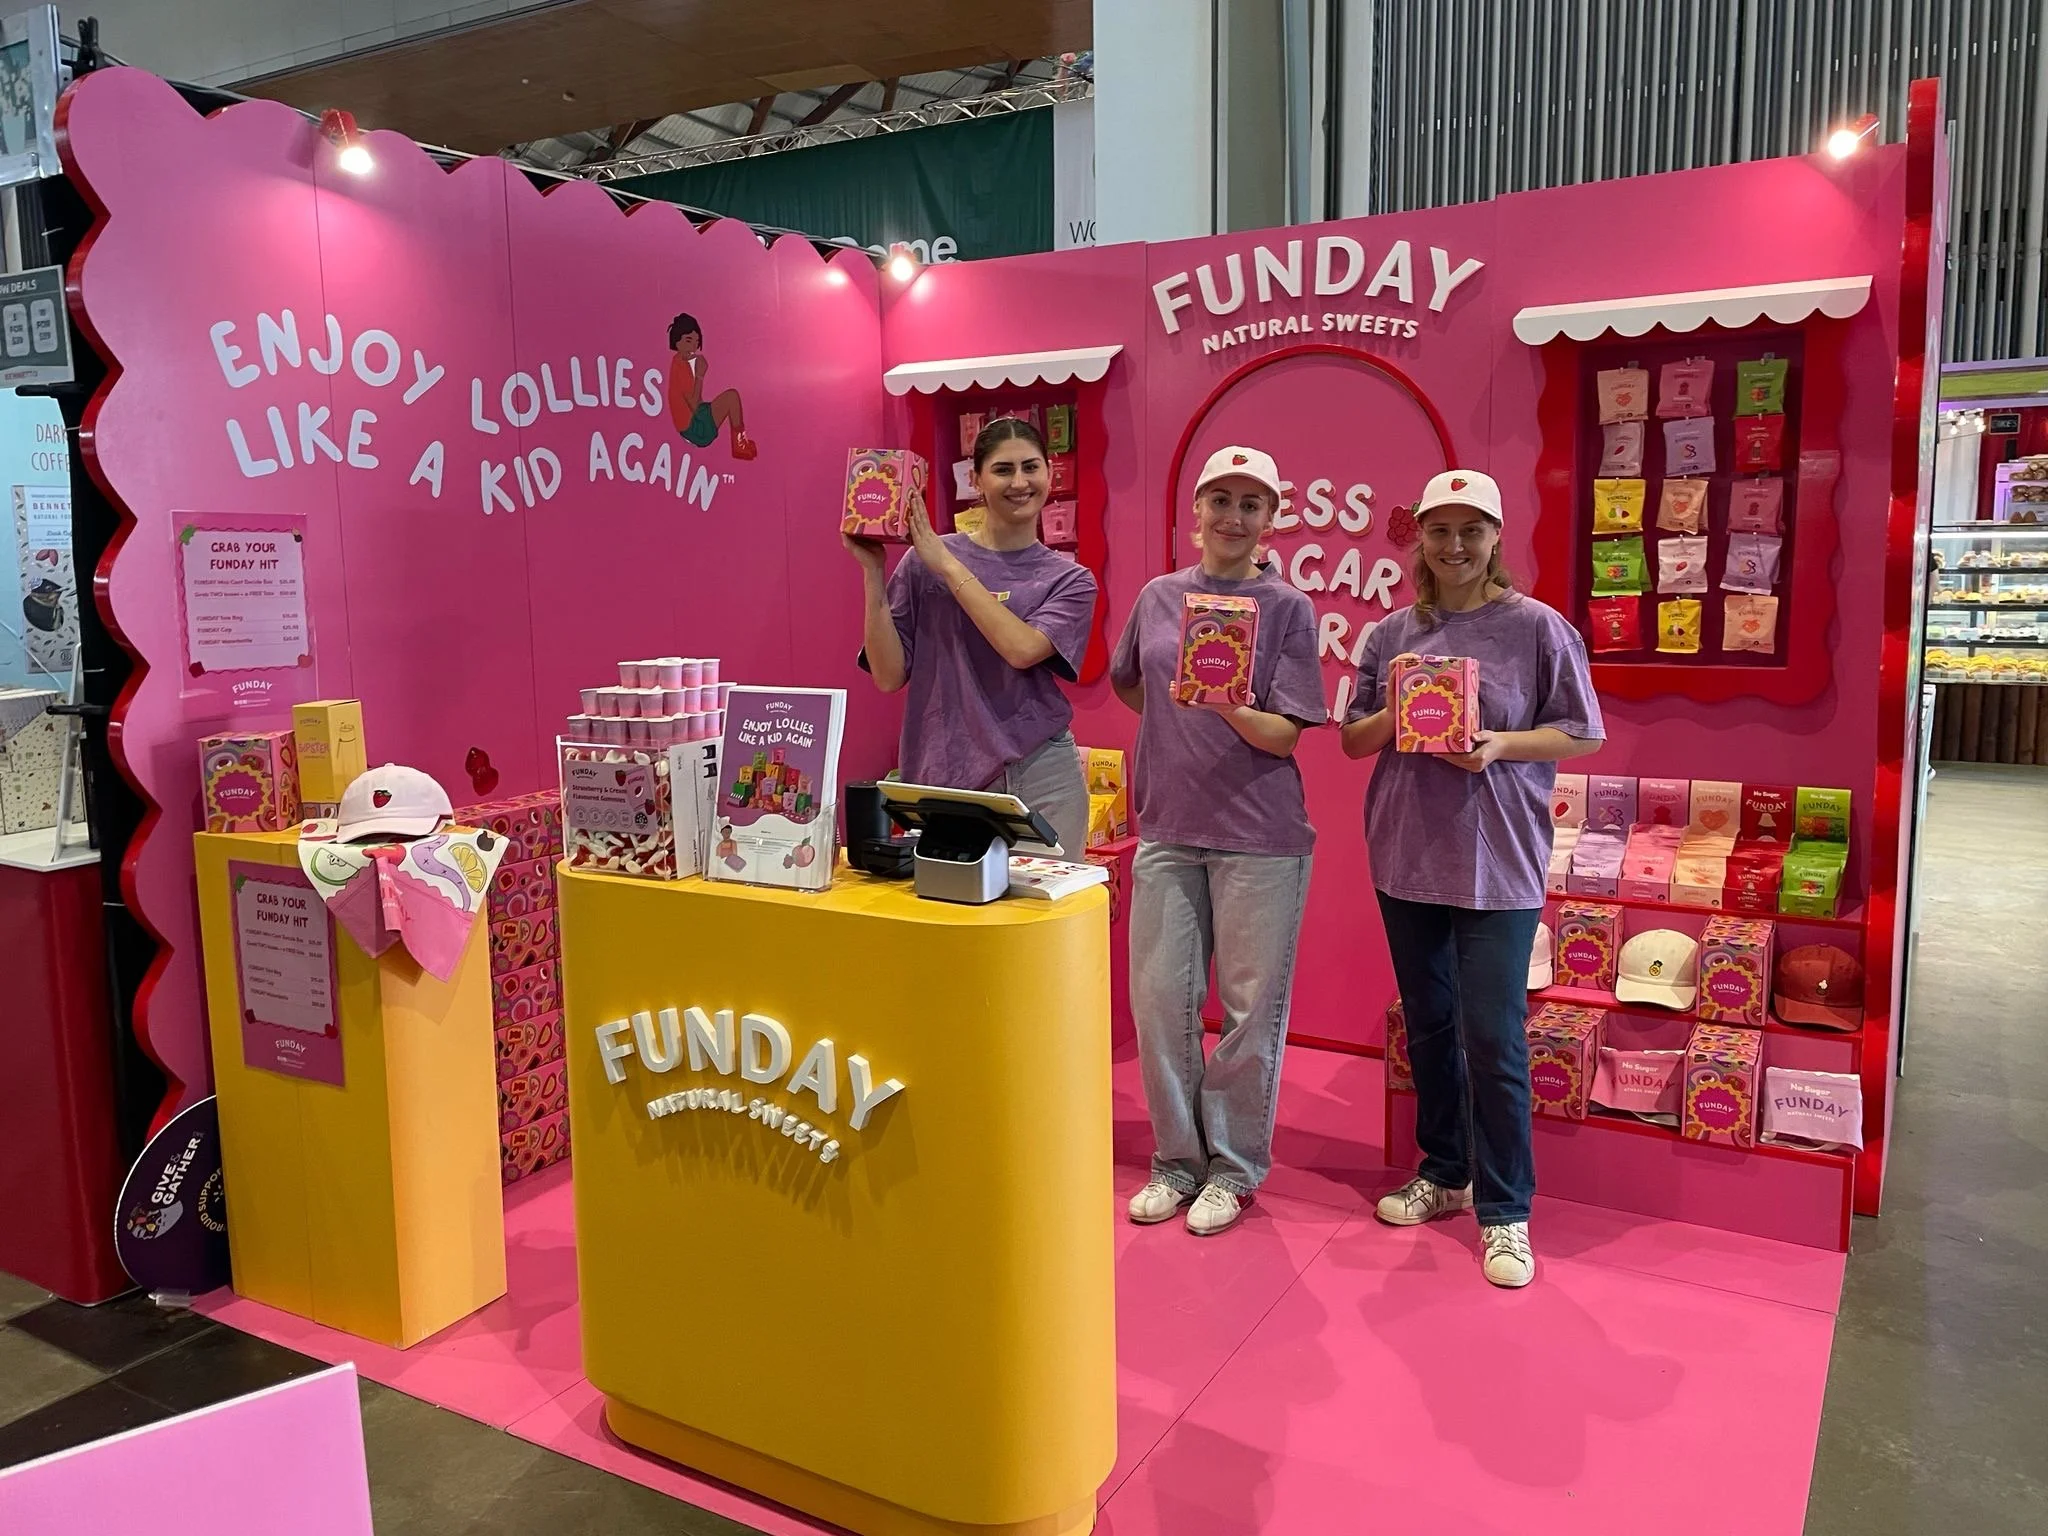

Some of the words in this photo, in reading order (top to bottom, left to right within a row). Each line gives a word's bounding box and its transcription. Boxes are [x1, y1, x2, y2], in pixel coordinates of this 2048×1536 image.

[11, 280, 37, 292] DEALS
[1152, 236, 1485, 335] FUNDAY
[1202, 314, 1314, 355] NATURAL
[1322, 313, 1420, 339] SWEETS
[210, 308, 445, 405] ENJOY
[471, 356, 663, 435] LOLLIES
[226, 402, 379, 478] LIKE
[409, 440, 444, 498] A
[480, 447, 562, 515] KID
[858, 493, 886, 502] FUNDAY
[211, 542, 240, 553] GRAB
[246, 542, 277, 553] YOUR
[210, 559, 253, 570] FUNDAY
[260, 559, 279, 570] HIT
[1196, 658, 1232, 668] FUNDAY
[232, 680, 273, 694] FUNDAY
[766, 702, 793, 710] FUNDAY
[1412, 708, 1446, 718] FUNDAY
[743, 719, 772, 732] ENJOY
[776, 718, 814, 734] LOLLIES
[738, 731, 756, 745] LIKE
[759, 736, 765, 746] A
[768, 732, 782, 744] KID
[572, 768, 598, 777] FUNDAY
[220, 788, 255, 798] FUNDAY
[572, 784, 602, 794] Strawberry
[1552, 787, 1580, 797] UNDAY
[1594, 790, 1629, 799] FUNDAY
[1696, 794, 1732, 804] FUNDAY
[1746, 799, 1787, 811] FUNDAY
[1803, 802, 1841, 812] FUNDAY
[257, 893, 279, 906] GRAB
[282, 896, 307, 910] YOUR
[257, 909, 290, 924] FUNDAY
[293, 916, 308, 928] HIT
[1568, 952, 1597, 961] FUNDAY
[1712, 984, 1745, 993] FUNDAY
[275, 1039, 306, 1053] FUNDAY
[596, 1006, 906, 1131] FUNDAY
[1622, 1061, 1633, 1070] No
[1634, 1063, 1659, 1073] Sugar
[1534, 1076, 1565, 1086] FUNDAY
[1611, 1074, 1675, 1090] FUNDAY
[1790, 1082, 1802, 1092] No
[1804, 1086, 1831, 1096] Sugar
[1699, 1102, 1734, 1112] FUNDAY
[1774, 1096, 1849, 1118] FUNDAY
[647, 1088, 748, 1120] NATURAL
[749, 1098, 840, 1163] SWEETS
[163, 1138, 201, 1205] GATHER
[151, 1163, 177, 1203] GIVE
[201, 1212, 226, 1232] ROUD
